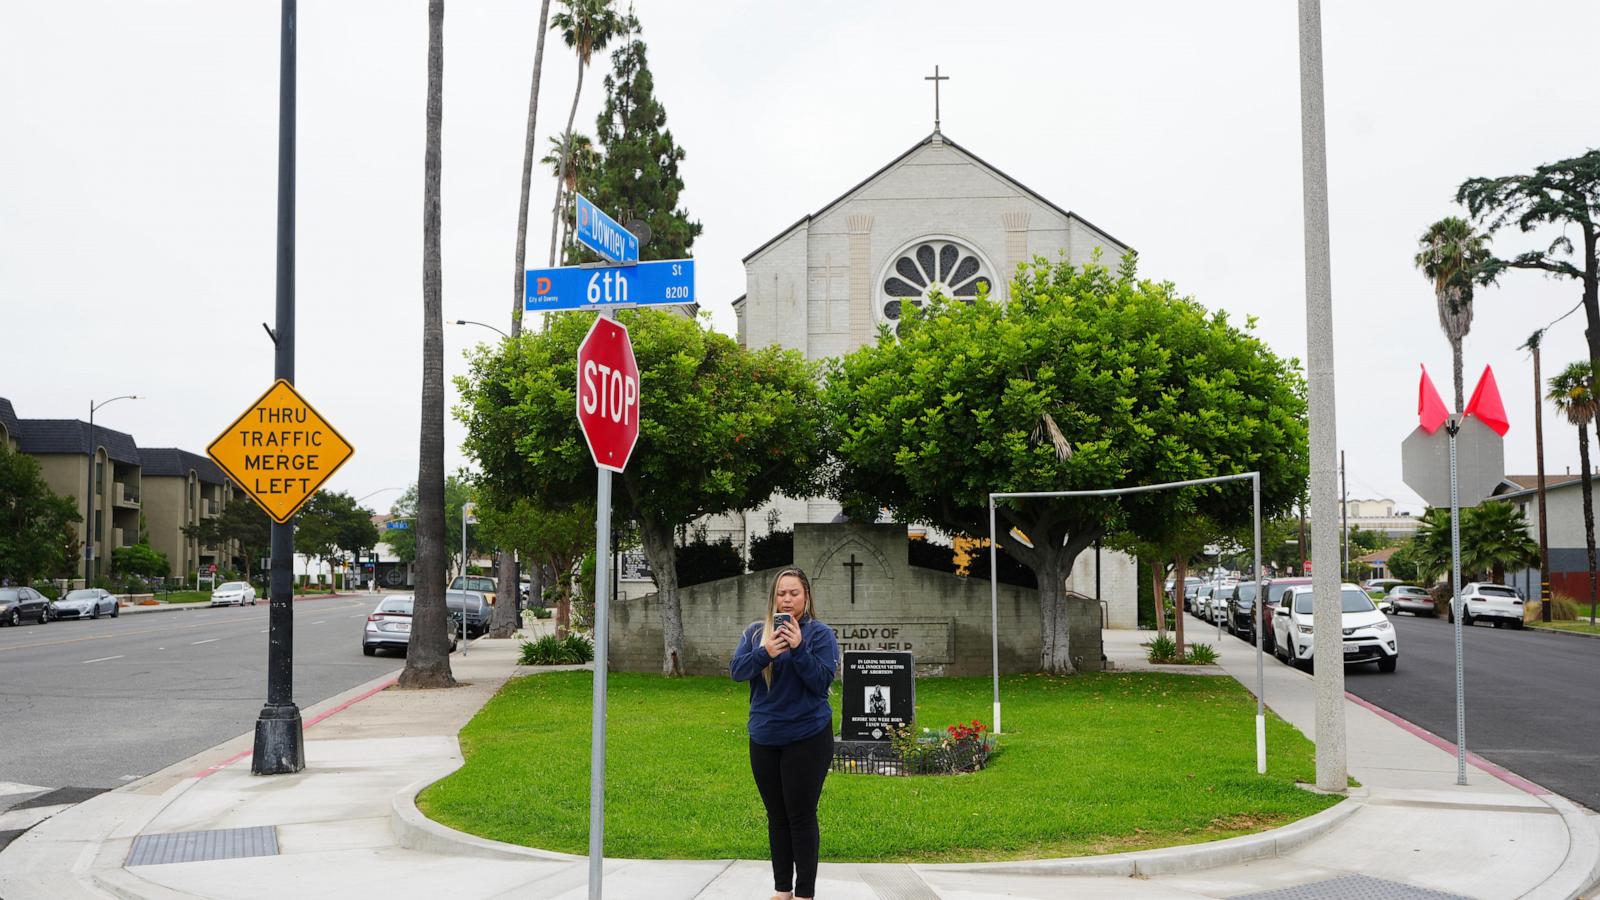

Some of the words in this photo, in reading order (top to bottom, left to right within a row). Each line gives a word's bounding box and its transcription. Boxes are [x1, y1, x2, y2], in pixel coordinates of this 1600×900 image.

[592, 208, 625, 262] Downey
[672, 264, 682, 276] St
[587, 270, 628, 303] 6th
[665, 286, 689, 299] 8200
[583, 360, 636, 425] STOP
[257, 408, 307, 423] THRU
[240, 431, 322, 447] TRAFFIC
[245, 455, 319, 470] MERGE
[256, 478, 310, 494] LEFT
[842, 628, 878, 639] LADY
[881, 628, 899, 639] OF
